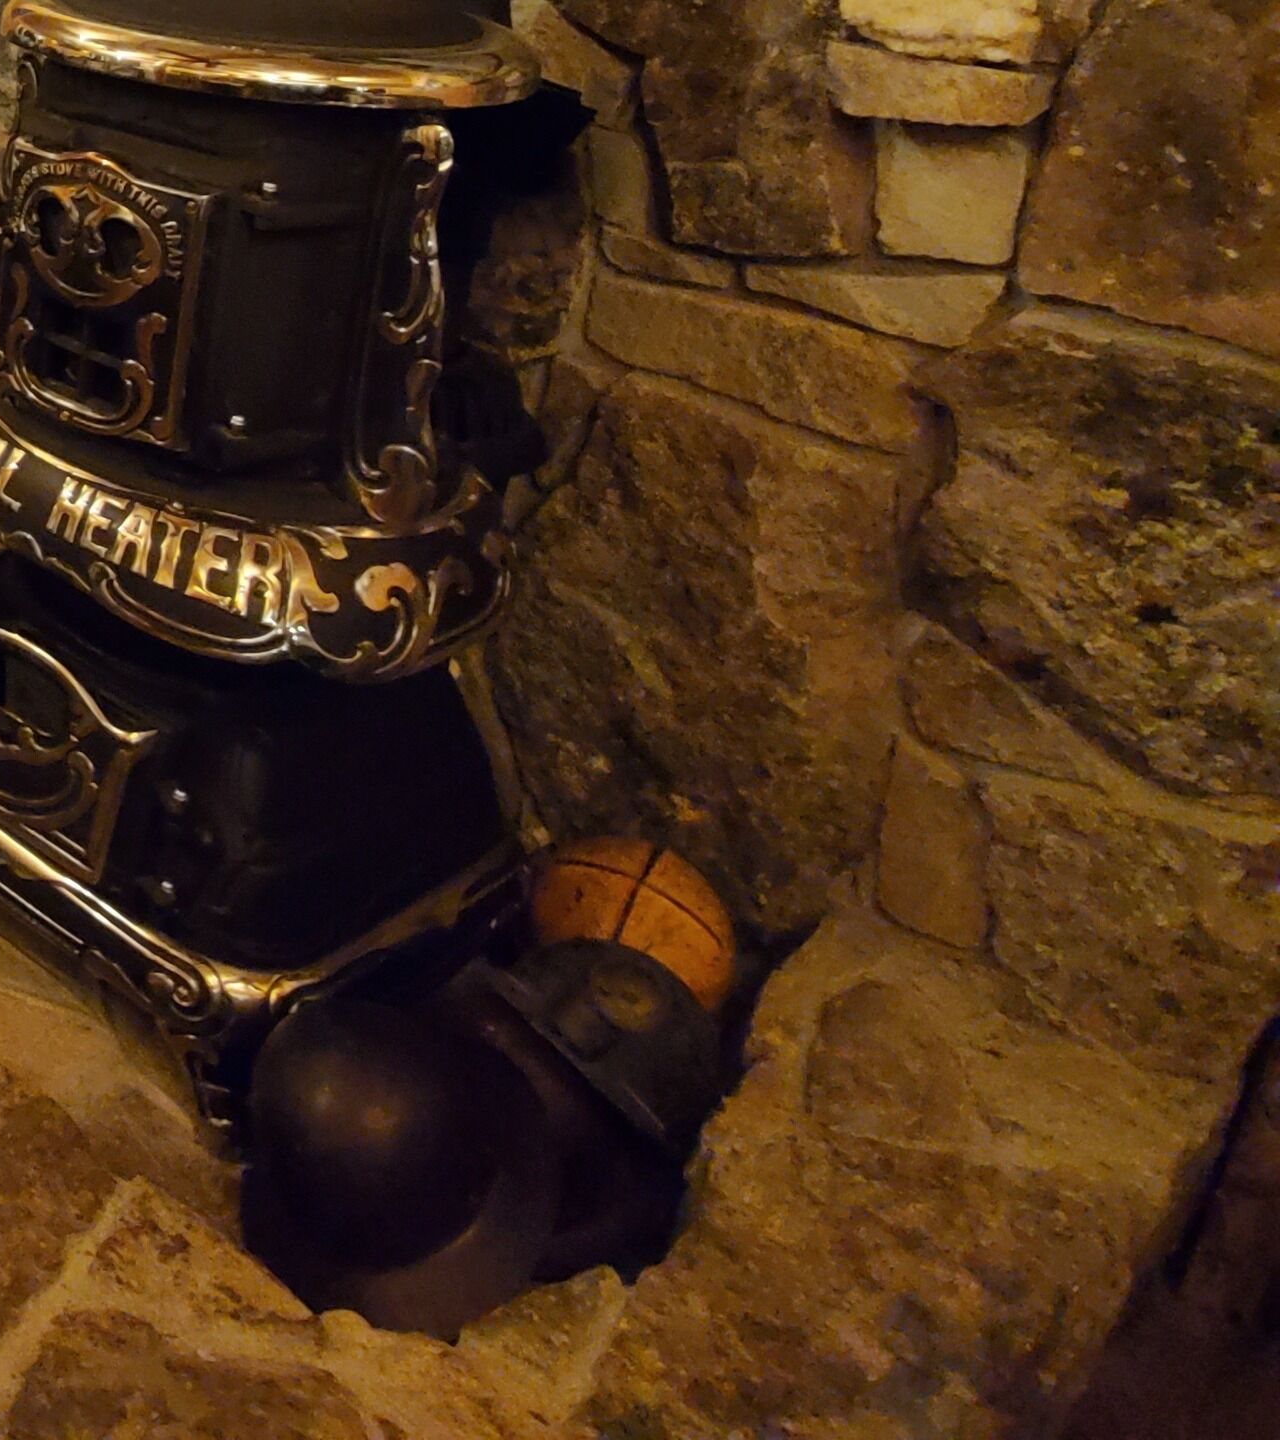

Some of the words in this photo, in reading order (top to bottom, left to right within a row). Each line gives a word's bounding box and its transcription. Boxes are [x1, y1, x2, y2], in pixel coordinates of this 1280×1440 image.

[40, 162, 82, 177] STOVE
[88, 166, 127, 194] WITH
[128, 183, 169, 220] THIS
[46, 476, 285, 626] HEATER
